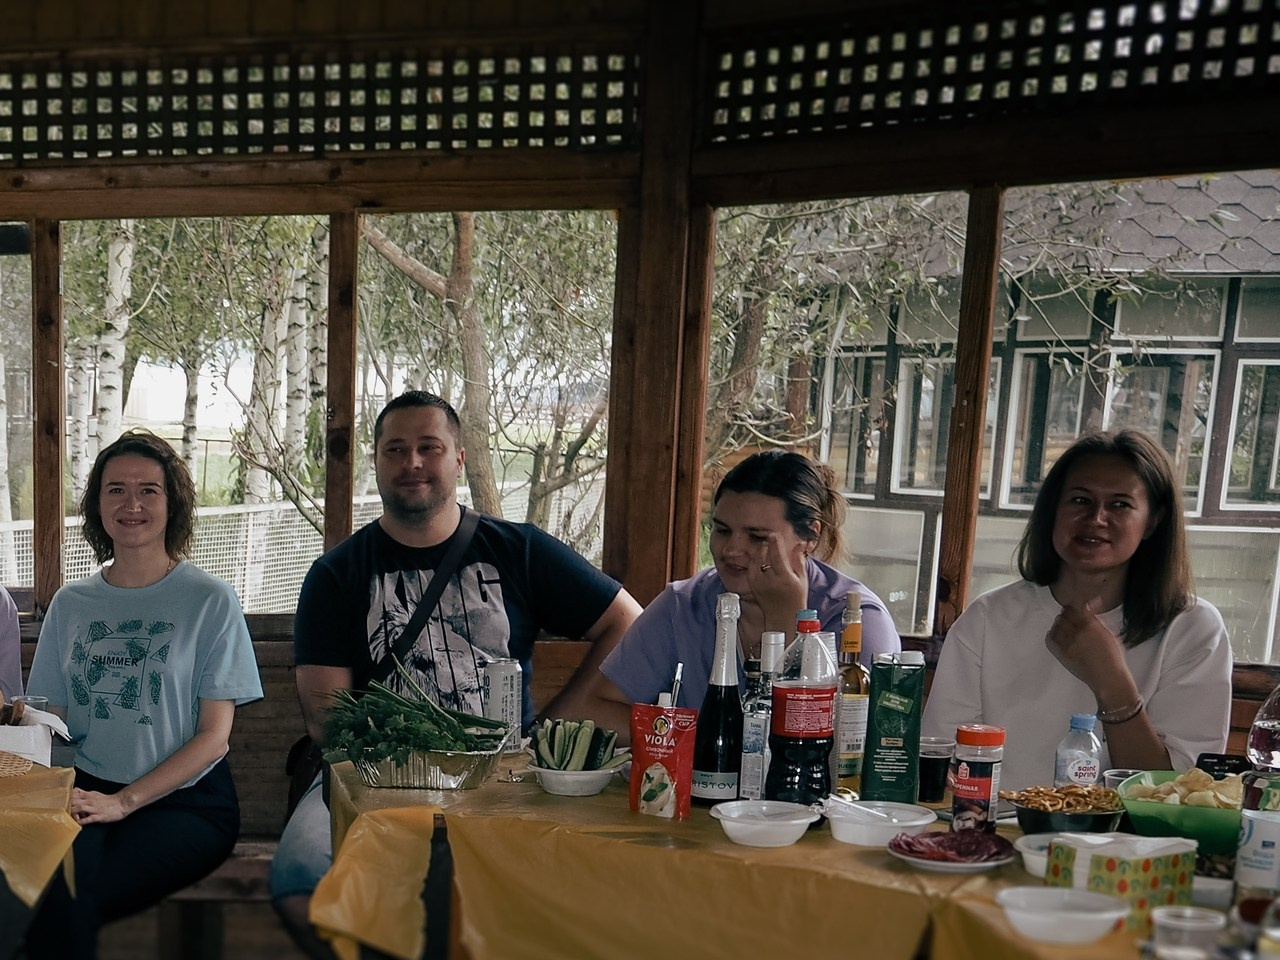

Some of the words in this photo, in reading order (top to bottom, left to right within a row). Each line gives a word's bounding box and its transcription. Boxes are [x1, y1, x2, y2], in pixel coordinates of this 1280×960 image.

[92, 655, 139, 667] SUMMER
[645, 734, 676, 747] VIOLA
[1074, 771, 1097, 779] spring
